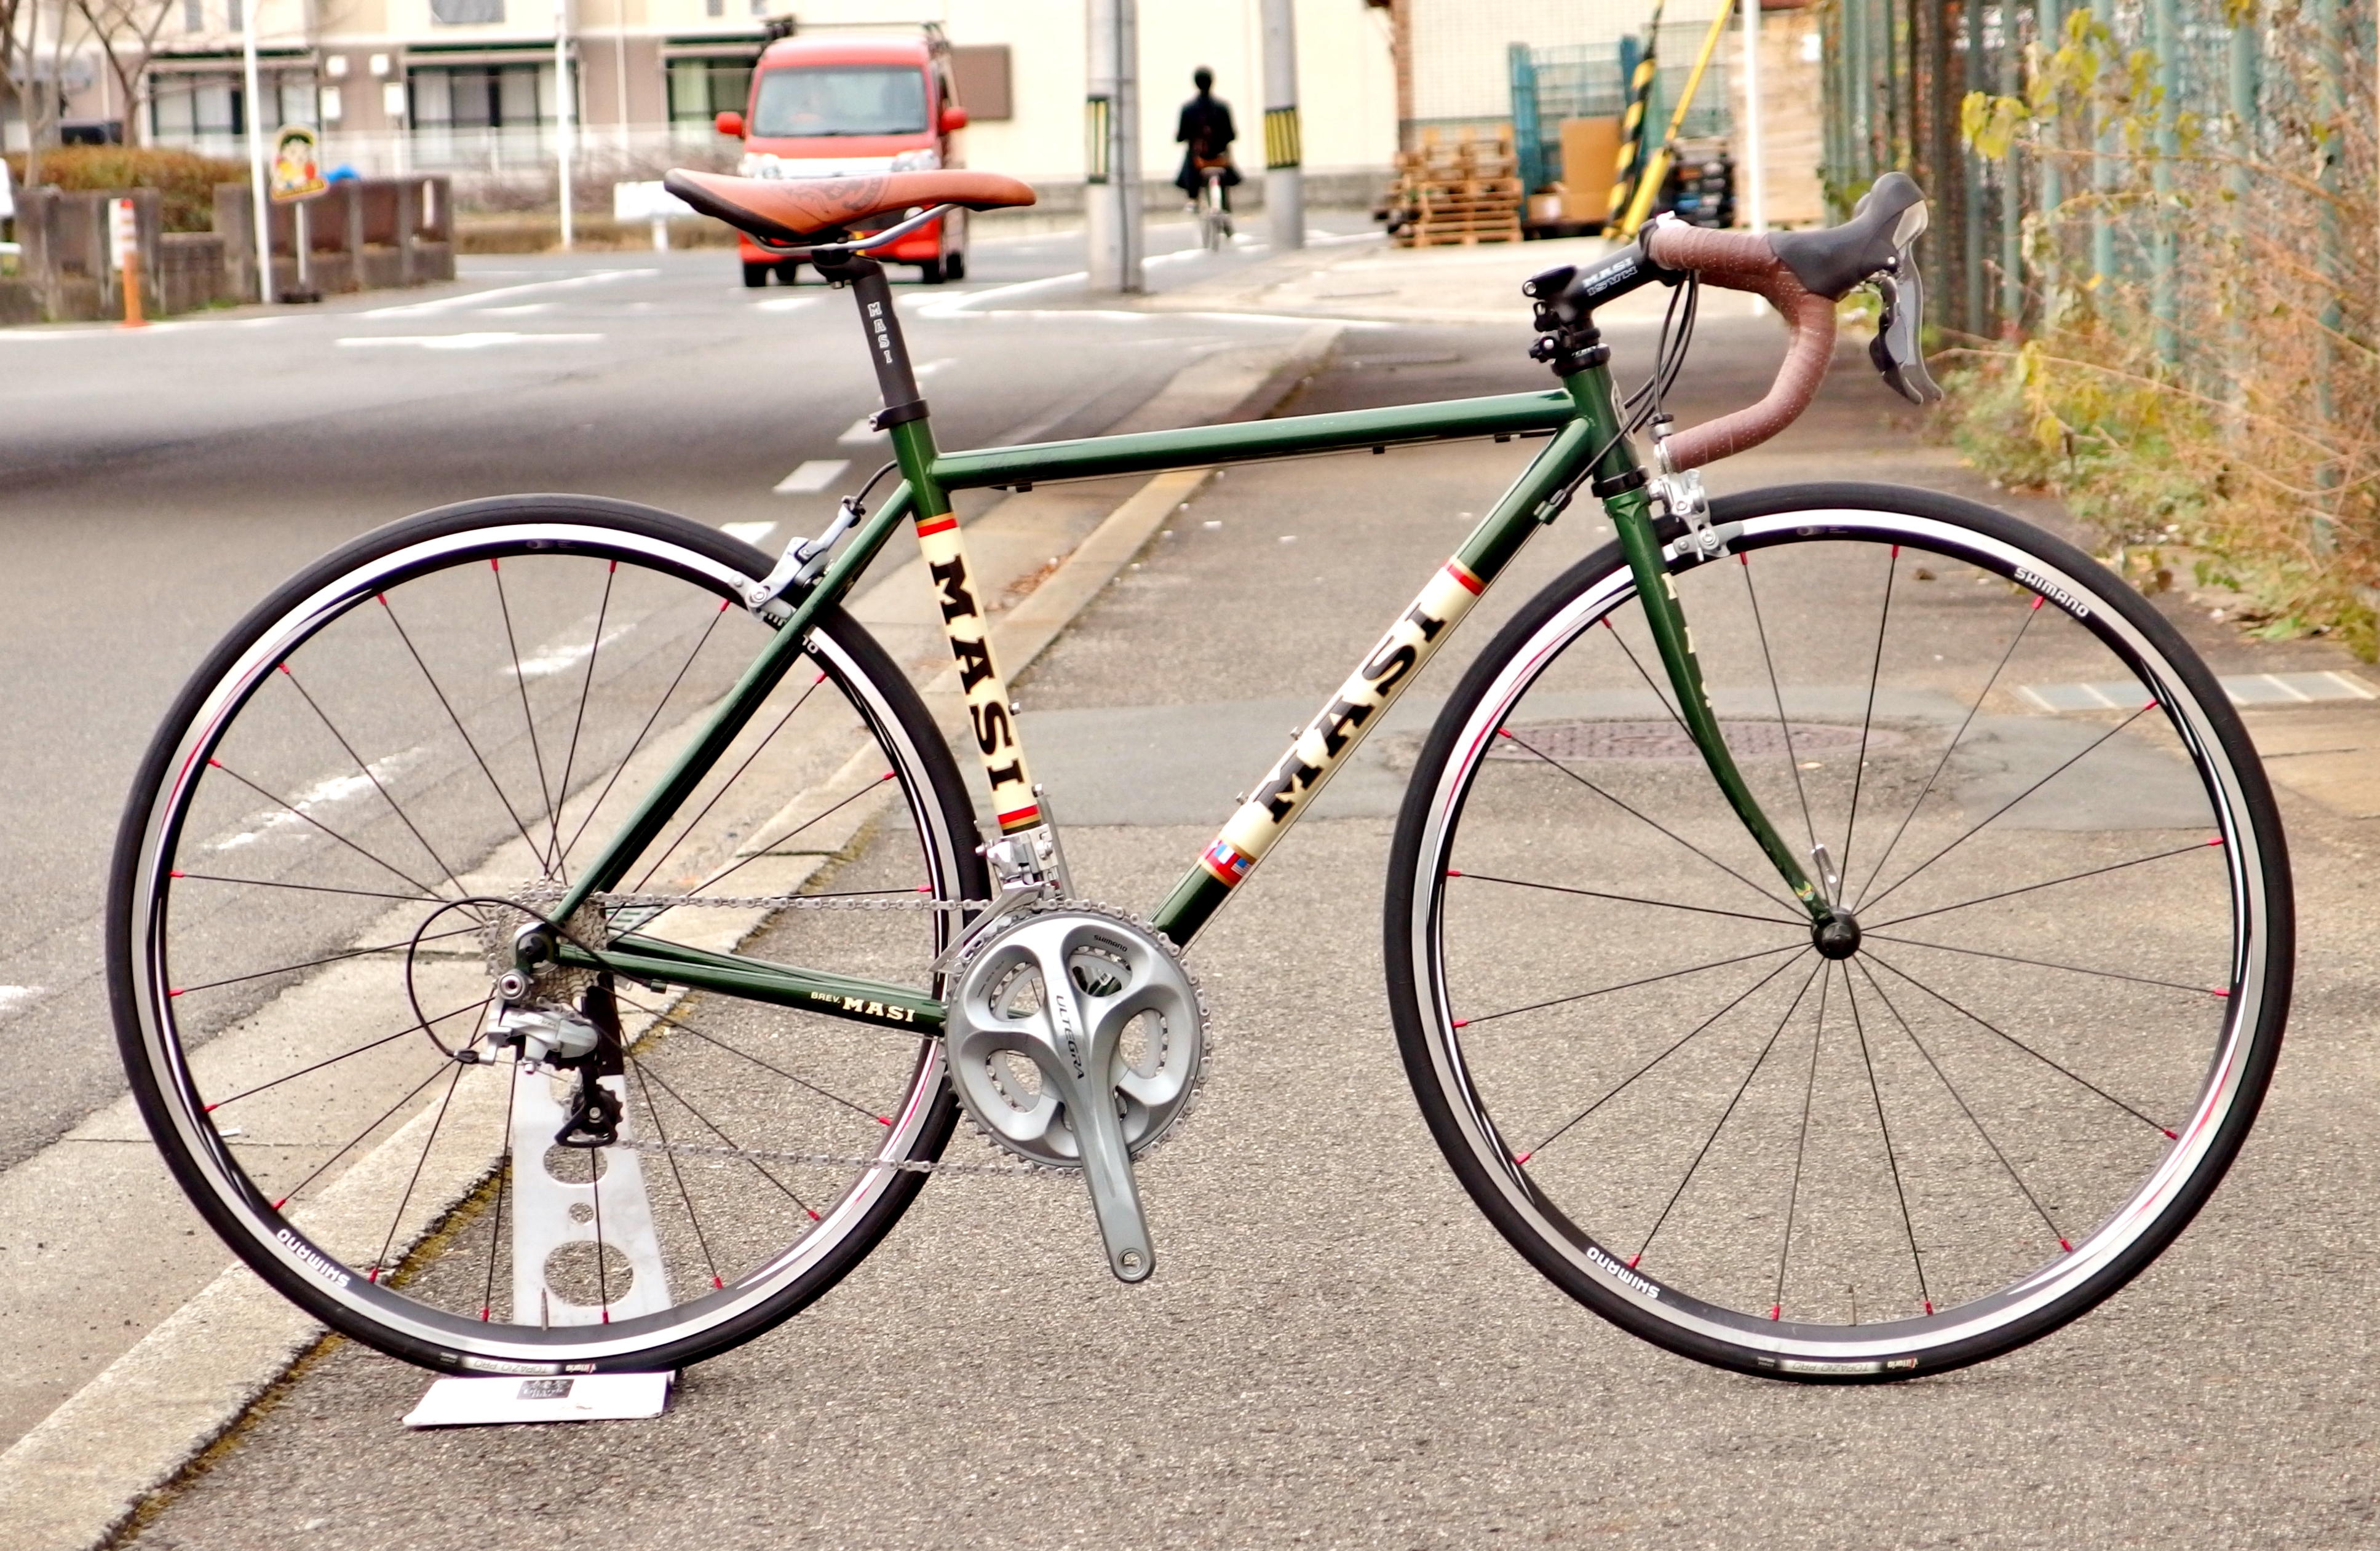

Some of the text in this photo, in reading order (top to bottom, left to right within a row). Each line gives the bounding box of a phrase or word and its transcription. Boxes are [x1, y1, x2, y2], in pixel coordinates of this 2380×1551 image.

[1587, 265, 1638, 296] MASI
[867, 301, 892, 363] MASI
[2014, 566, 2089, 617] SHIMANO
[929, 553, 1025, 792] MASI
[1251, 601, 1447, 825] MASI
[1094, 935, 1127, 952] SHIMANO
[811, 991, 915, 1022] BREV. MASI
[1056, 995, 1085, 1080] ULTEGRA
[277, 1229, 351, 1287] SHIMANO
[1586, 1247, 1660, 1299] SHIMANO
[474, 1360, 498, 1370] PRO
[501, 1362, 547, 1373] TOPAZIO
[1793, 1362, 1816, 1371] PRO
